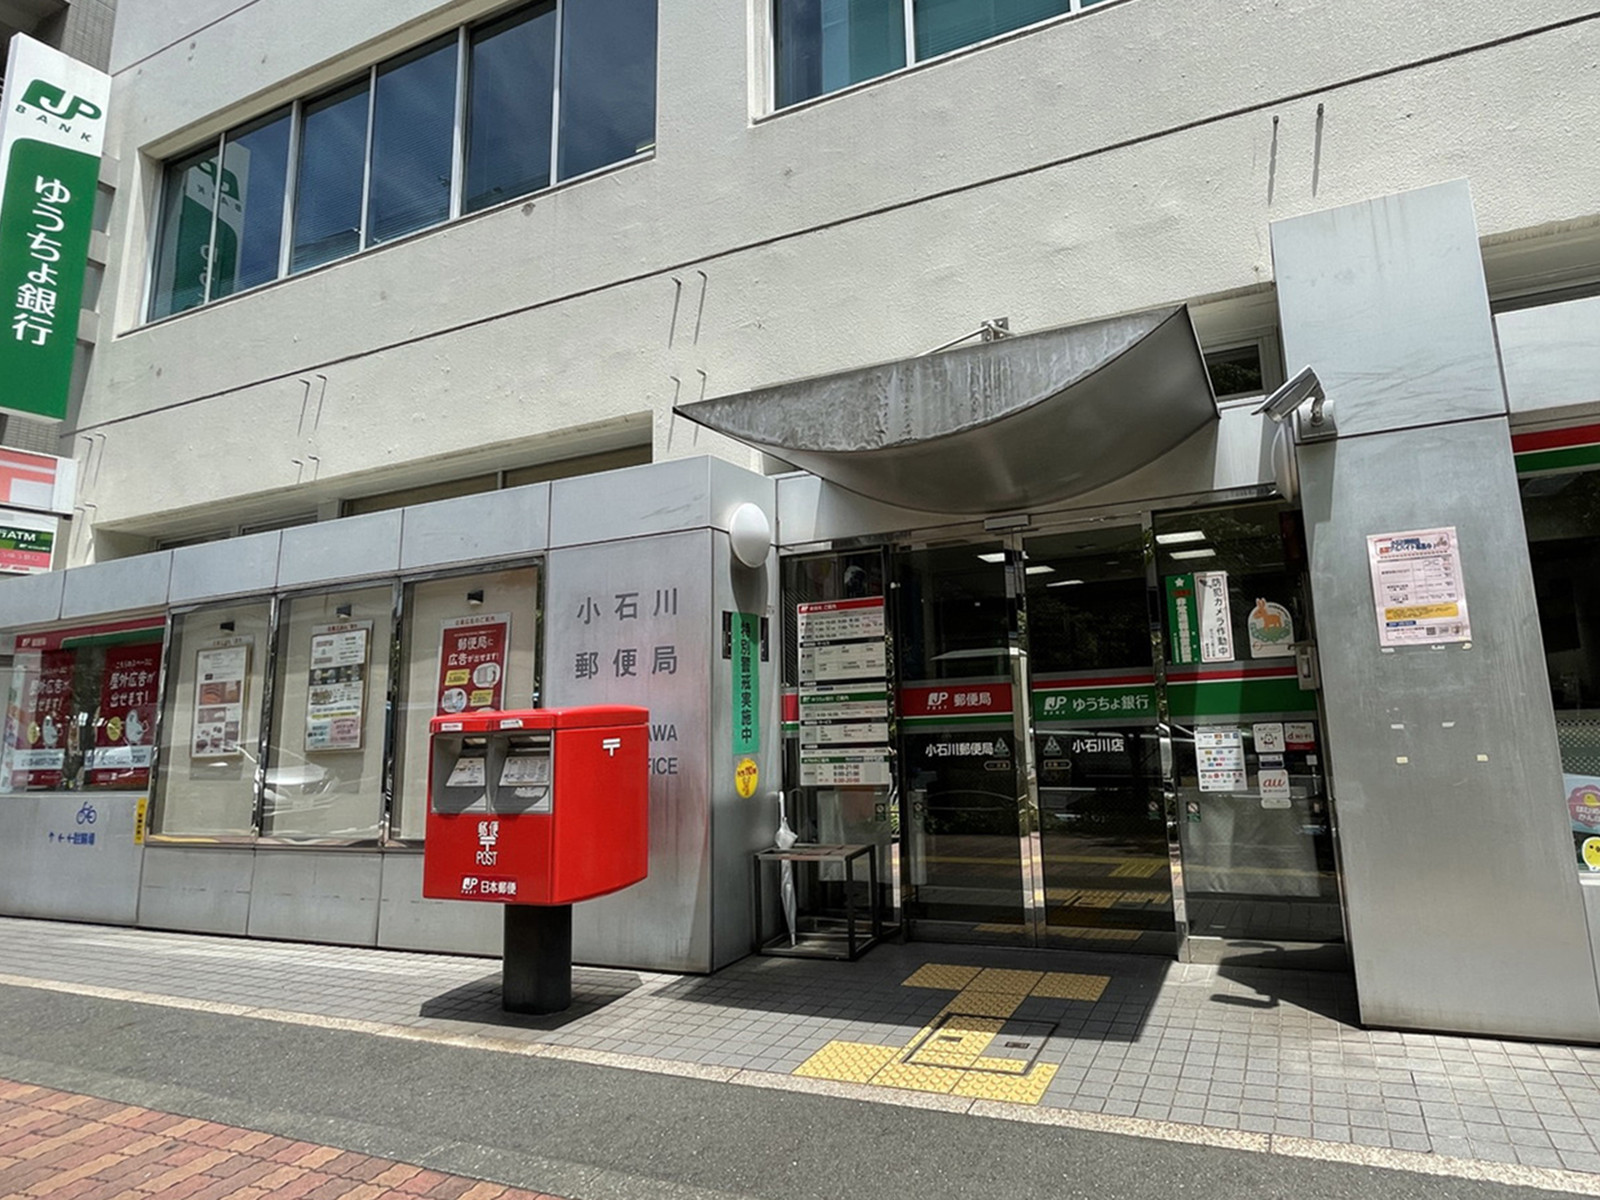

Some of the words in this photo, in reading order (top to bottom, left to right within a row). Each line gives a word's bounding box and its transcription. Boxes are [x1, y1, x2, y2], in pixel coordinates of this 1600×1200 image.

[15, 104, 92, 142] BANK
[12, 175, 71, 346] ゆうちょ銀行
[577, 588, 678, 625] 小石川
[1212, 578, 1228, 655] 防犯カメラ作動中
[458, 636, 494, 650] 郵便局に
[575, 646, 678, 680] 郵便局
[954, 692, 991, 706] 郵便局
[1072, 695, 1149, 712] ゆうちょ銀行
[925, 742, 994, 757] 小石川郵便局
[1072, 738, 1125, 753] 小石川店
[1263, 778, 1286, 788] au
[478, 821, 499, 838] 郵便
[476, 850, 498, 866] POST
[481, 880, 517, 896] 日本郵便
